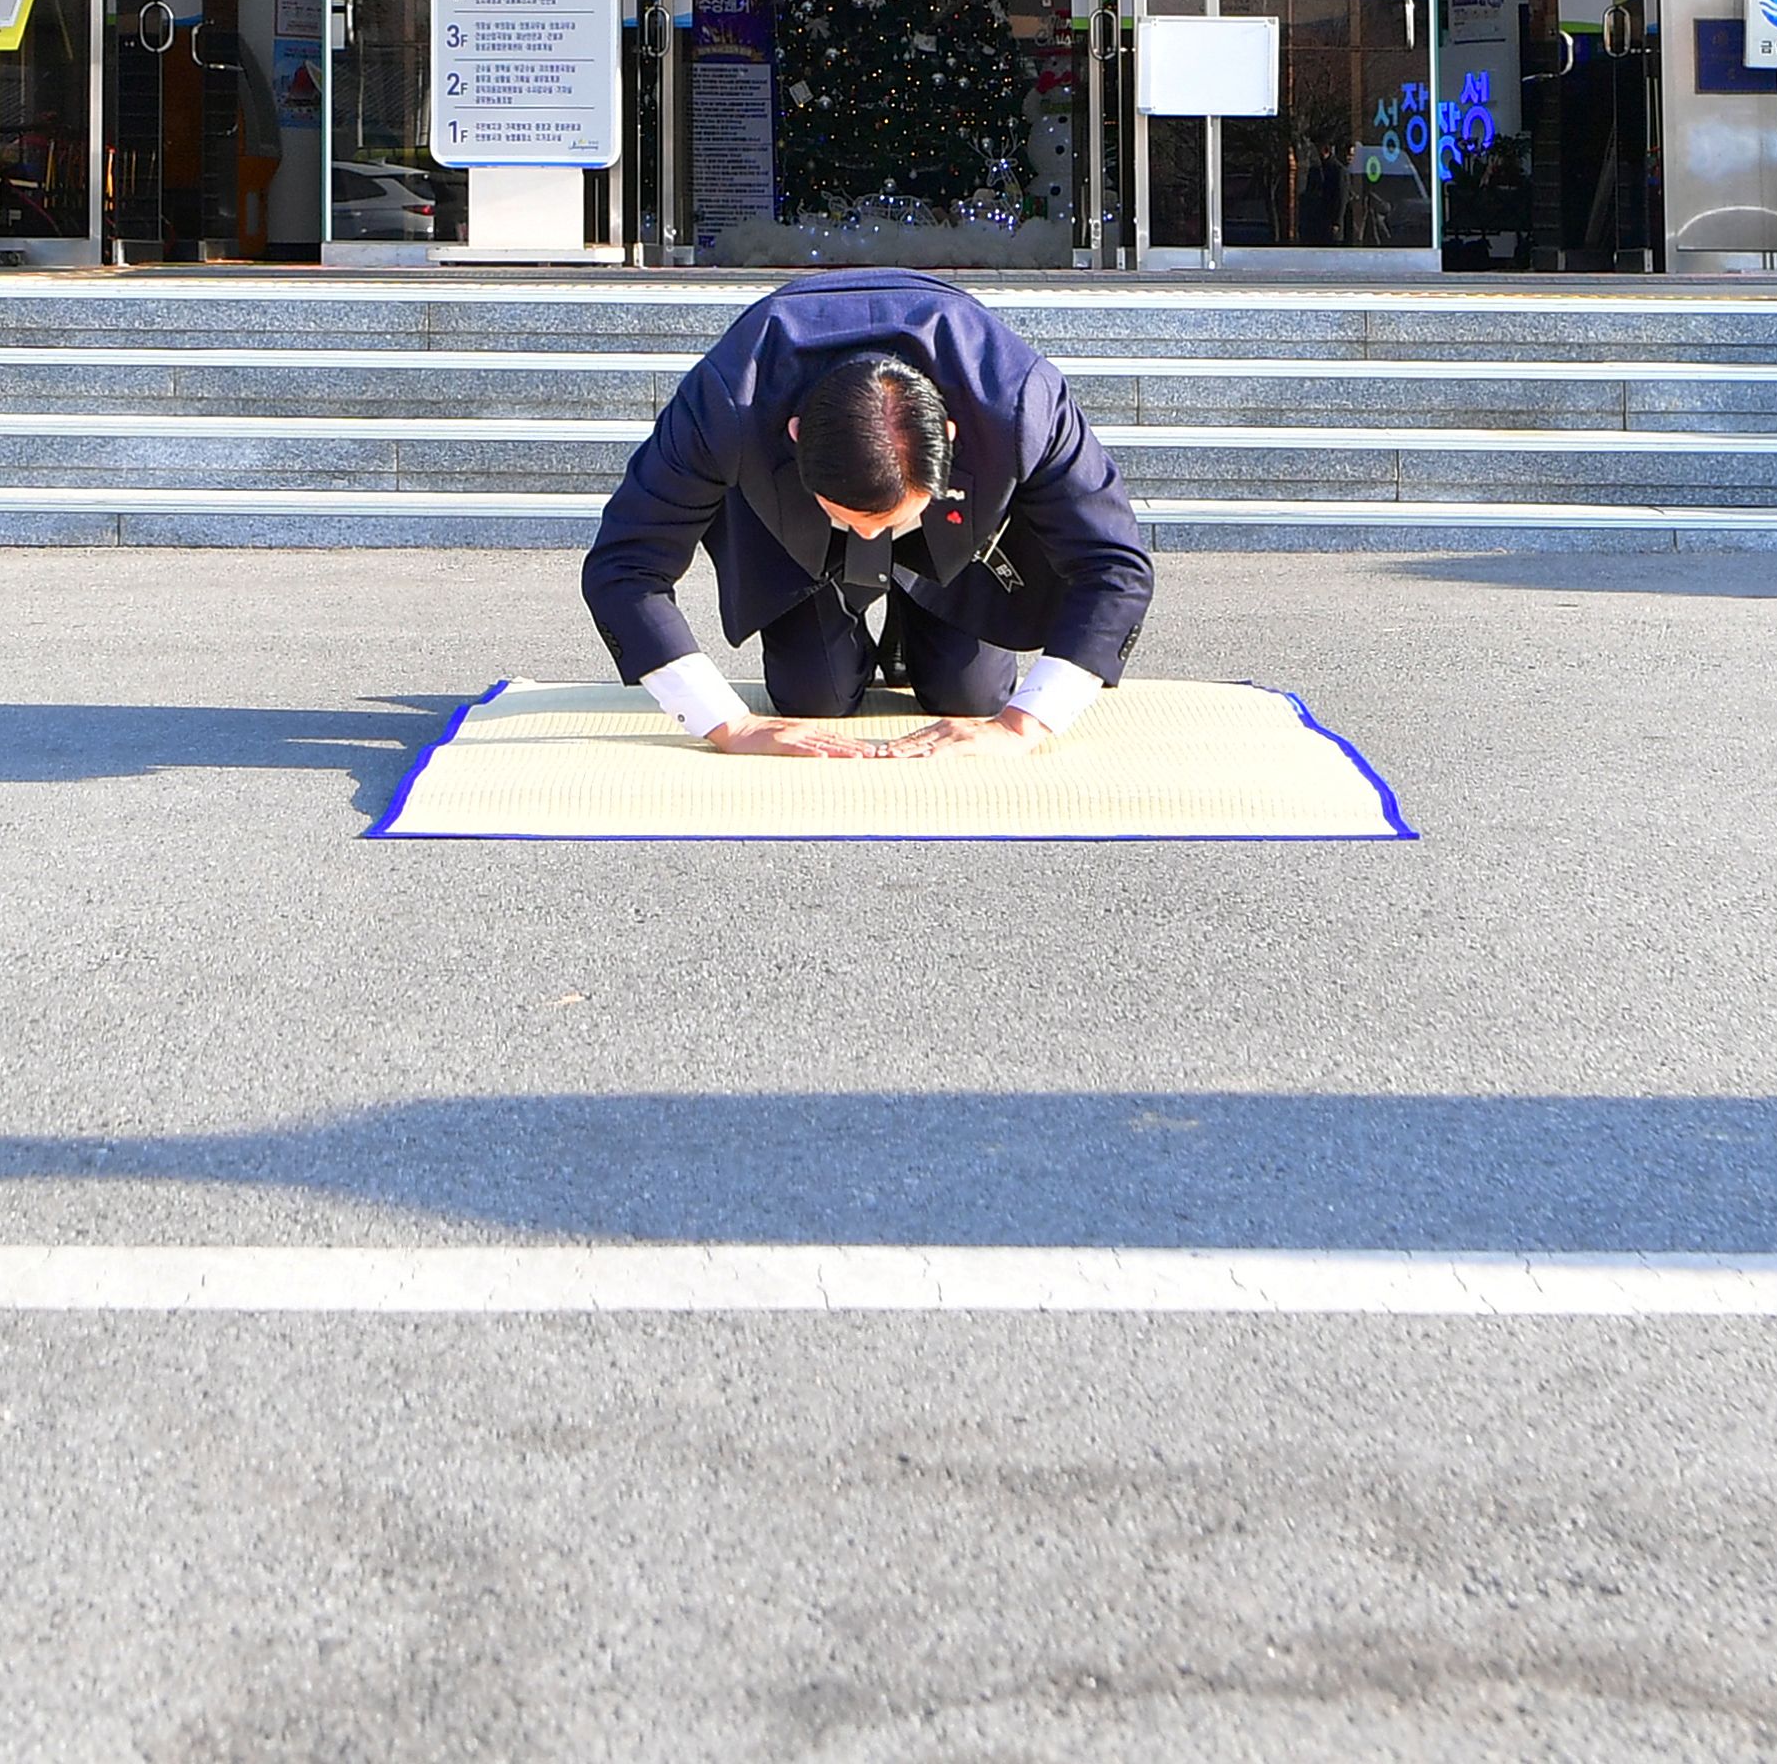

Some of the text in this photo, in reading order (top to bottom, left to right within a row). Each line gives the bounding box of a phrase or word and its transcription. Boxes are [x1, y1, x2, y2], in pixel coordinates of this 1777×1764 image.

[446, 24, 468, 48] 3F
[446, 72, 468, 96] 2F
[448, 120, 468, 144] 1F
